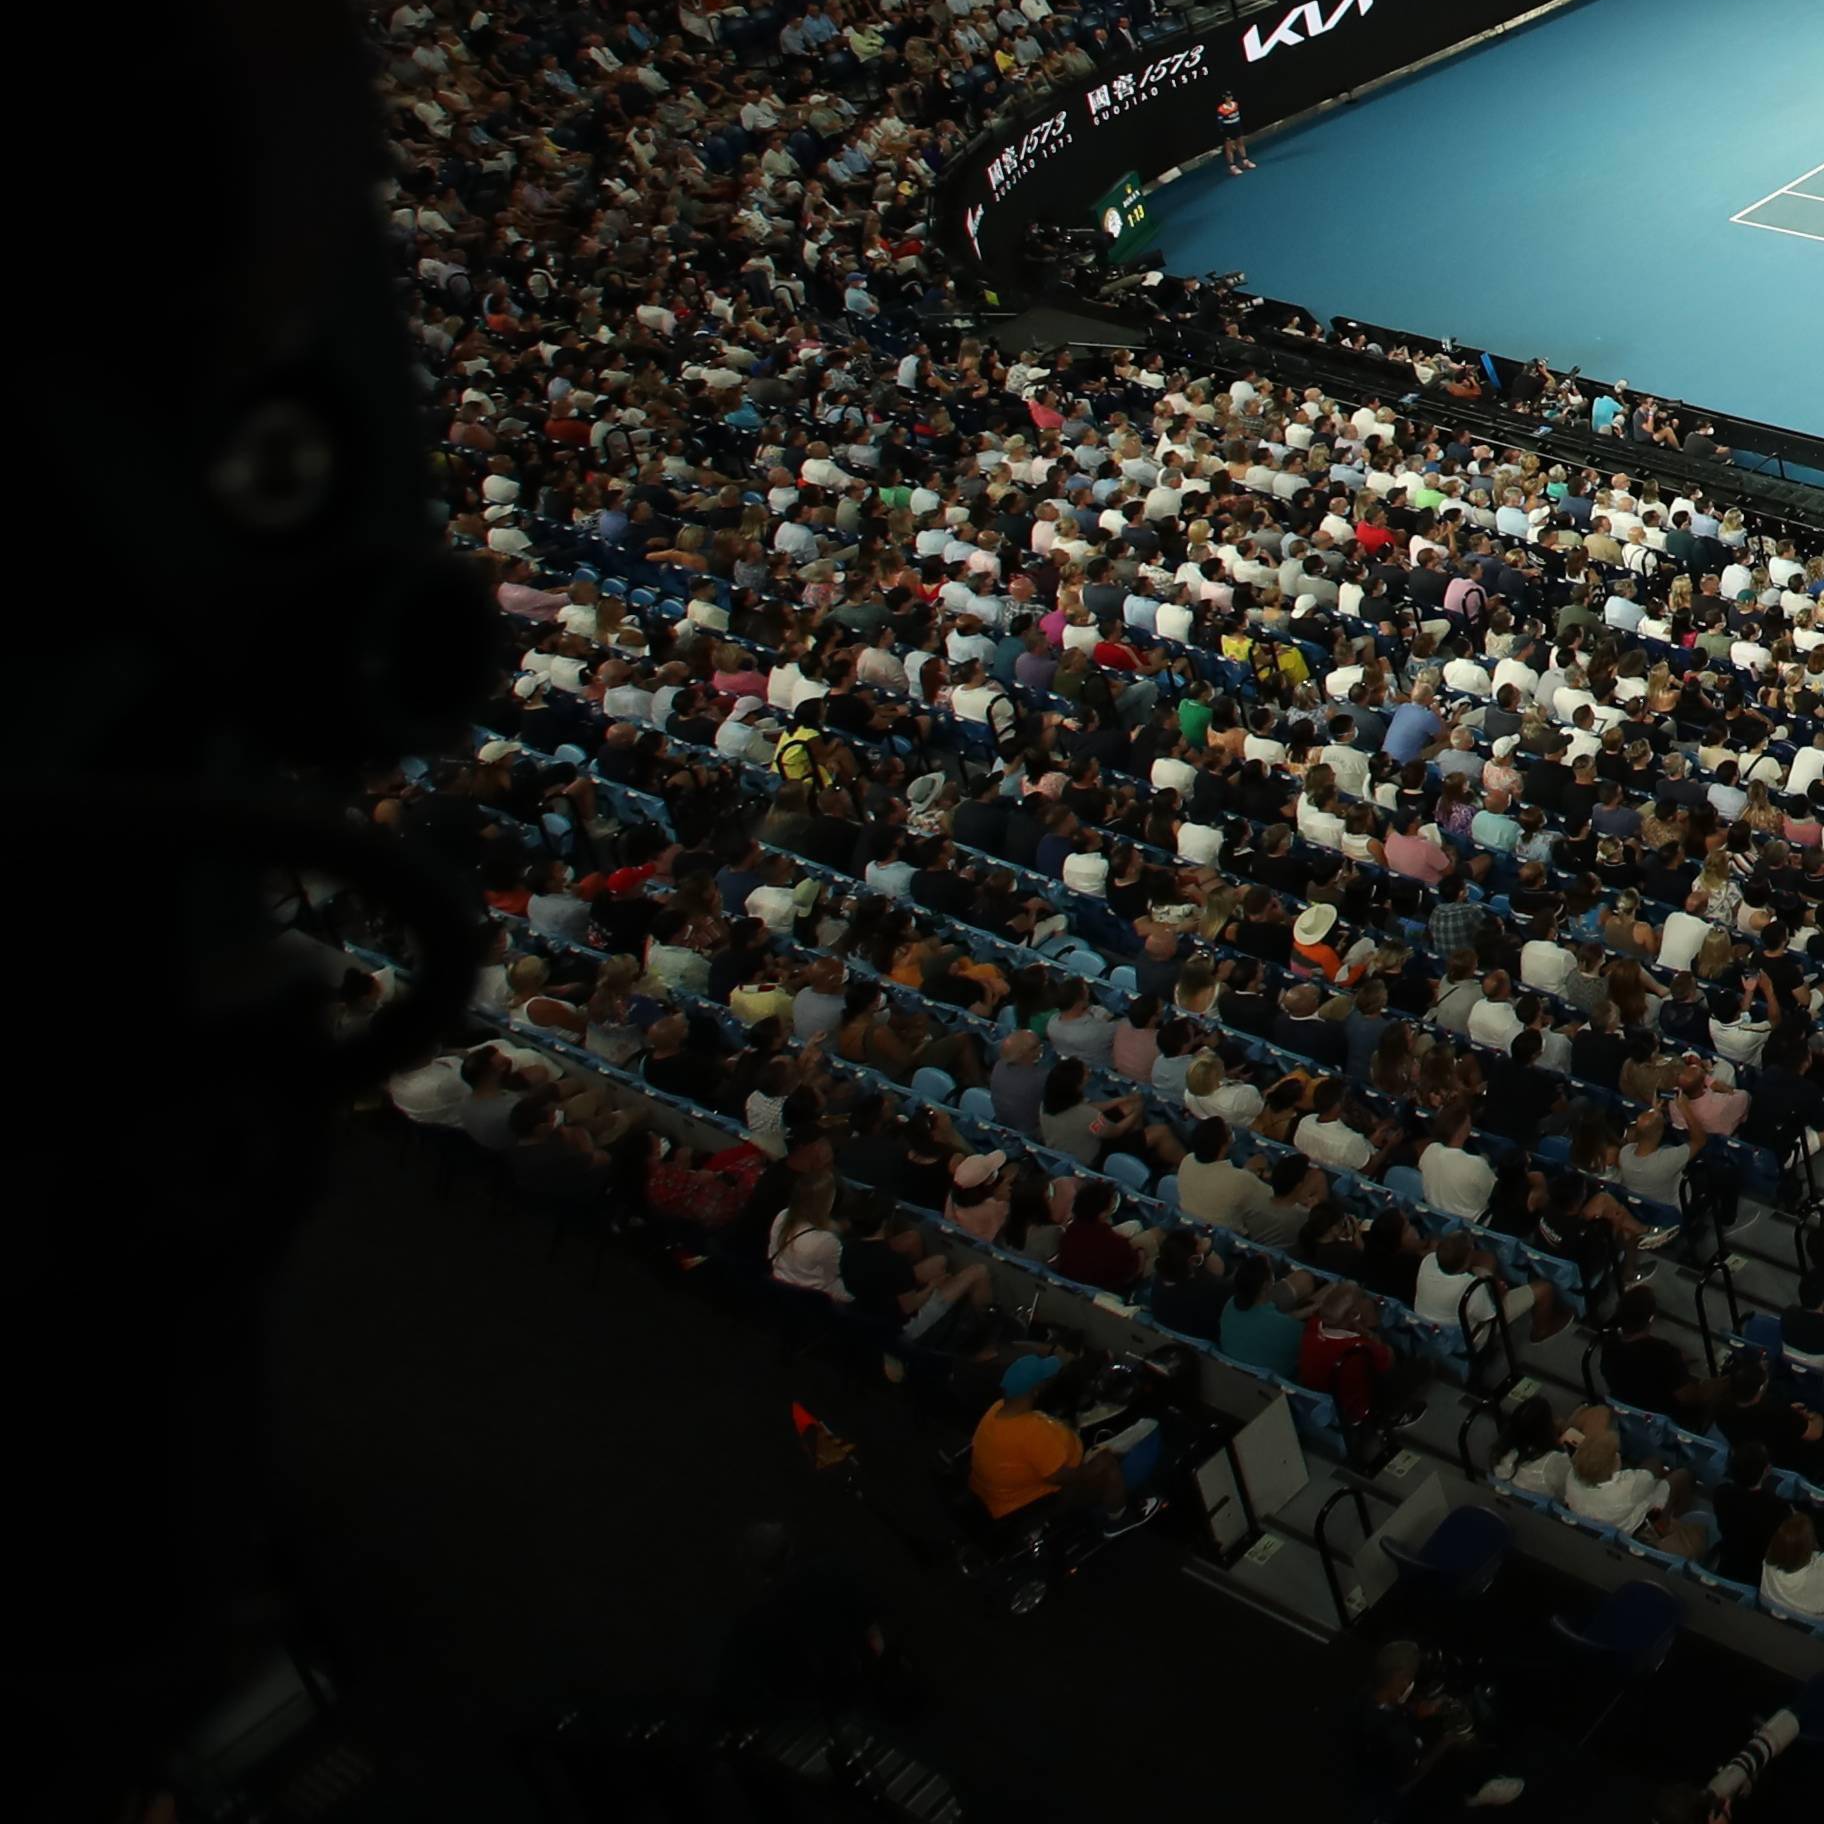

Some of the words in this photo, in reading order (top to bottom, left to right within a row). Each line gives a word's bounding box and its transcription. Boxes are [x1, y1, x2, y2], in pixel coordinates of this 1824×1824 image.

[1139, 44, 1205, 88] 1573
[1093, 87, 1158, 126] GUOJIAO
[1171, 66, 1209, 87] 1573
[1019, 110, 1067, 160] 1573
